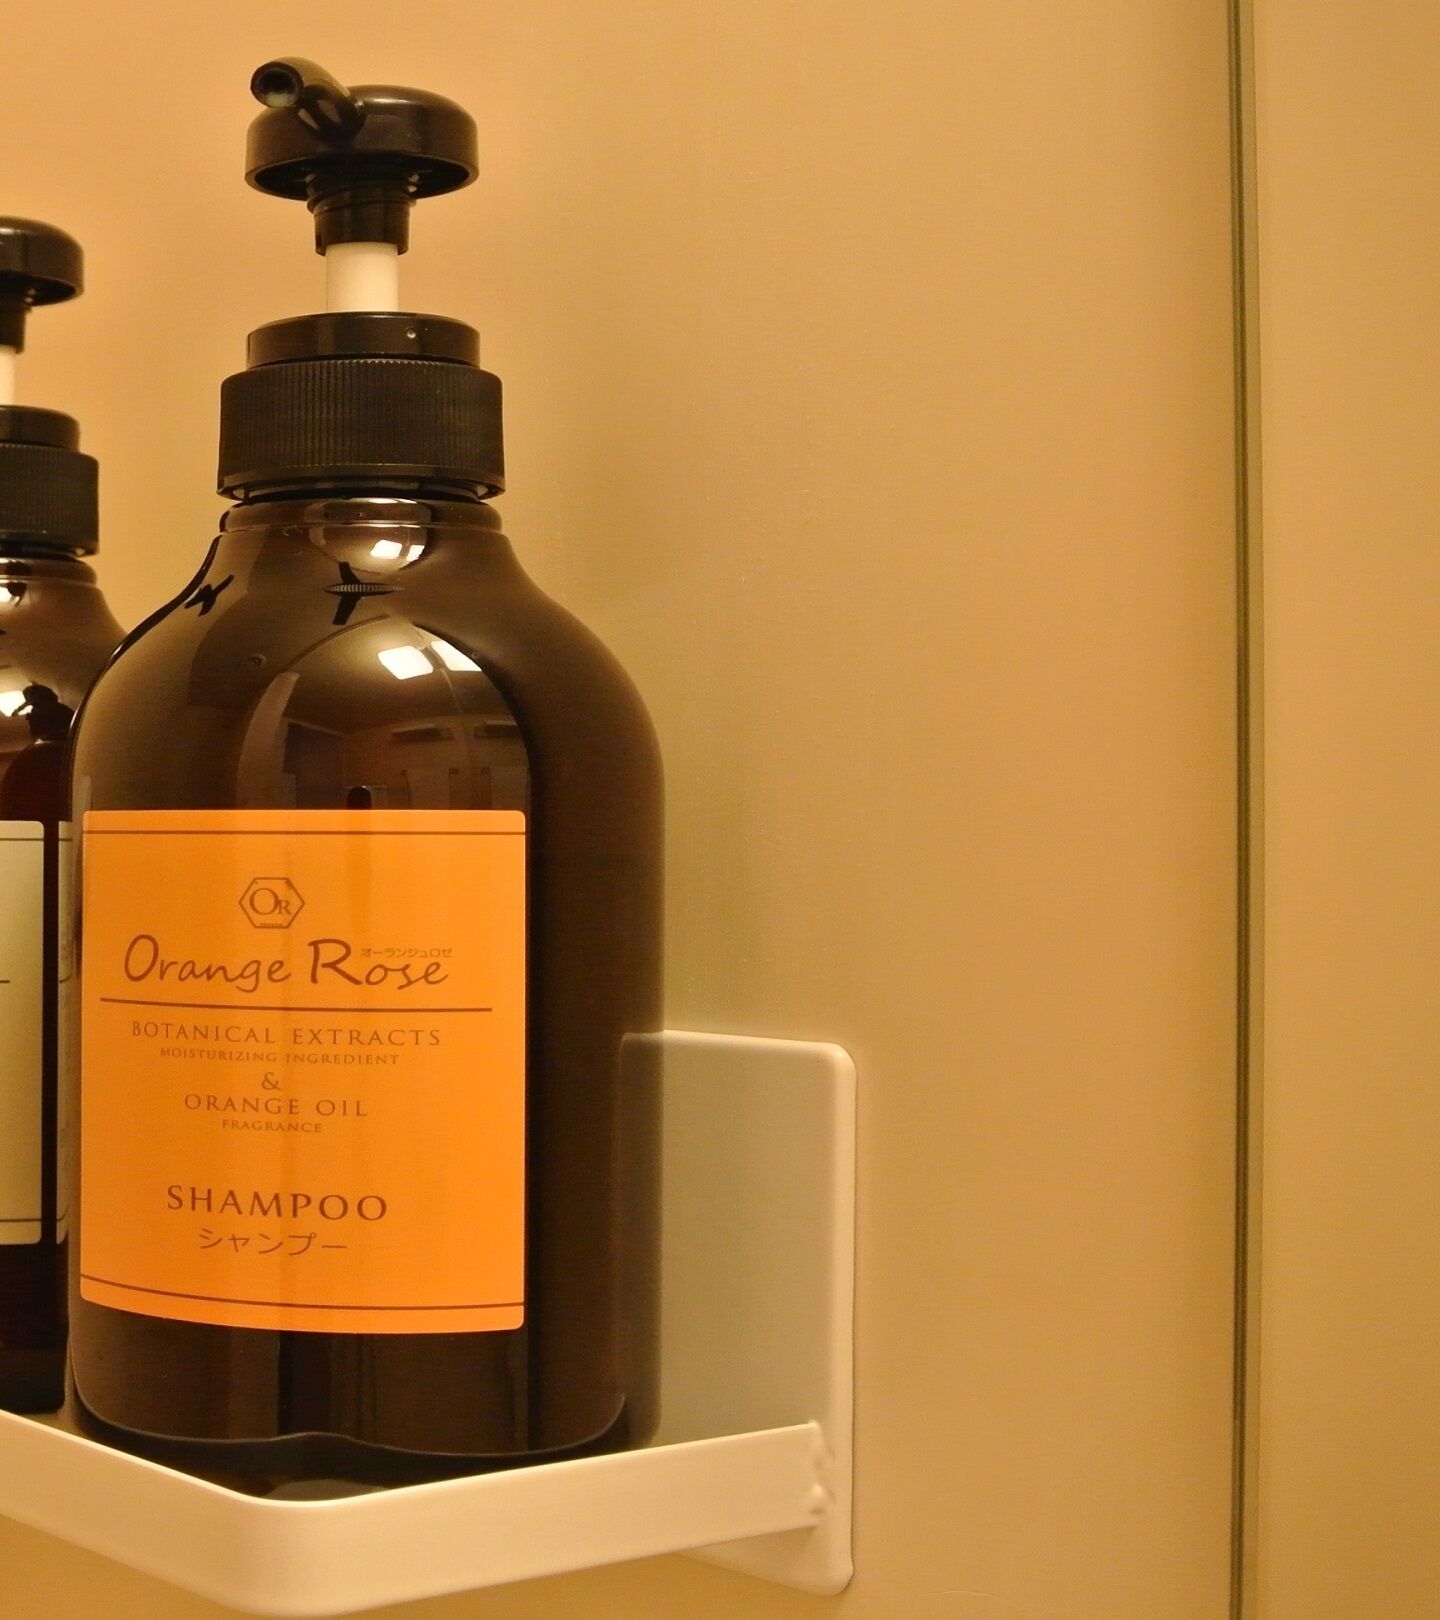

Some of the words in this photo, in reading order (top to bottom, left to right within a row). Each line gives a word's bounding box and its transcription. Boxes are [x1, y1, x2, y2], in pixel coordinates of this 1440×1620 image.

[249, 888, 291, 916] OR
[124, 934, 291, 993] Orange
[308, 938, 449, 990] Rose
[361, 948, 453, 959] オーランジュロゼ
[131, 1020, 277, 1045] BOTANICAL
[292, 1028, 441, 1047] EXTRACTS
[160, 1047, 277, 1063] MOISTURIZING
[286, 1053, 400, 1065] INGREDIENT
[261, 1072, 281, 1091] &
[184, 1093, 300, 1116] ORANGE
[316, 1099, 369, 1117] OIL
[222, 1119, 323, 1134] FRAGRANCE
[166, 1184, 387, 1221] SHAMPOO
[199, 1227, 348, 1256] シャンプー
